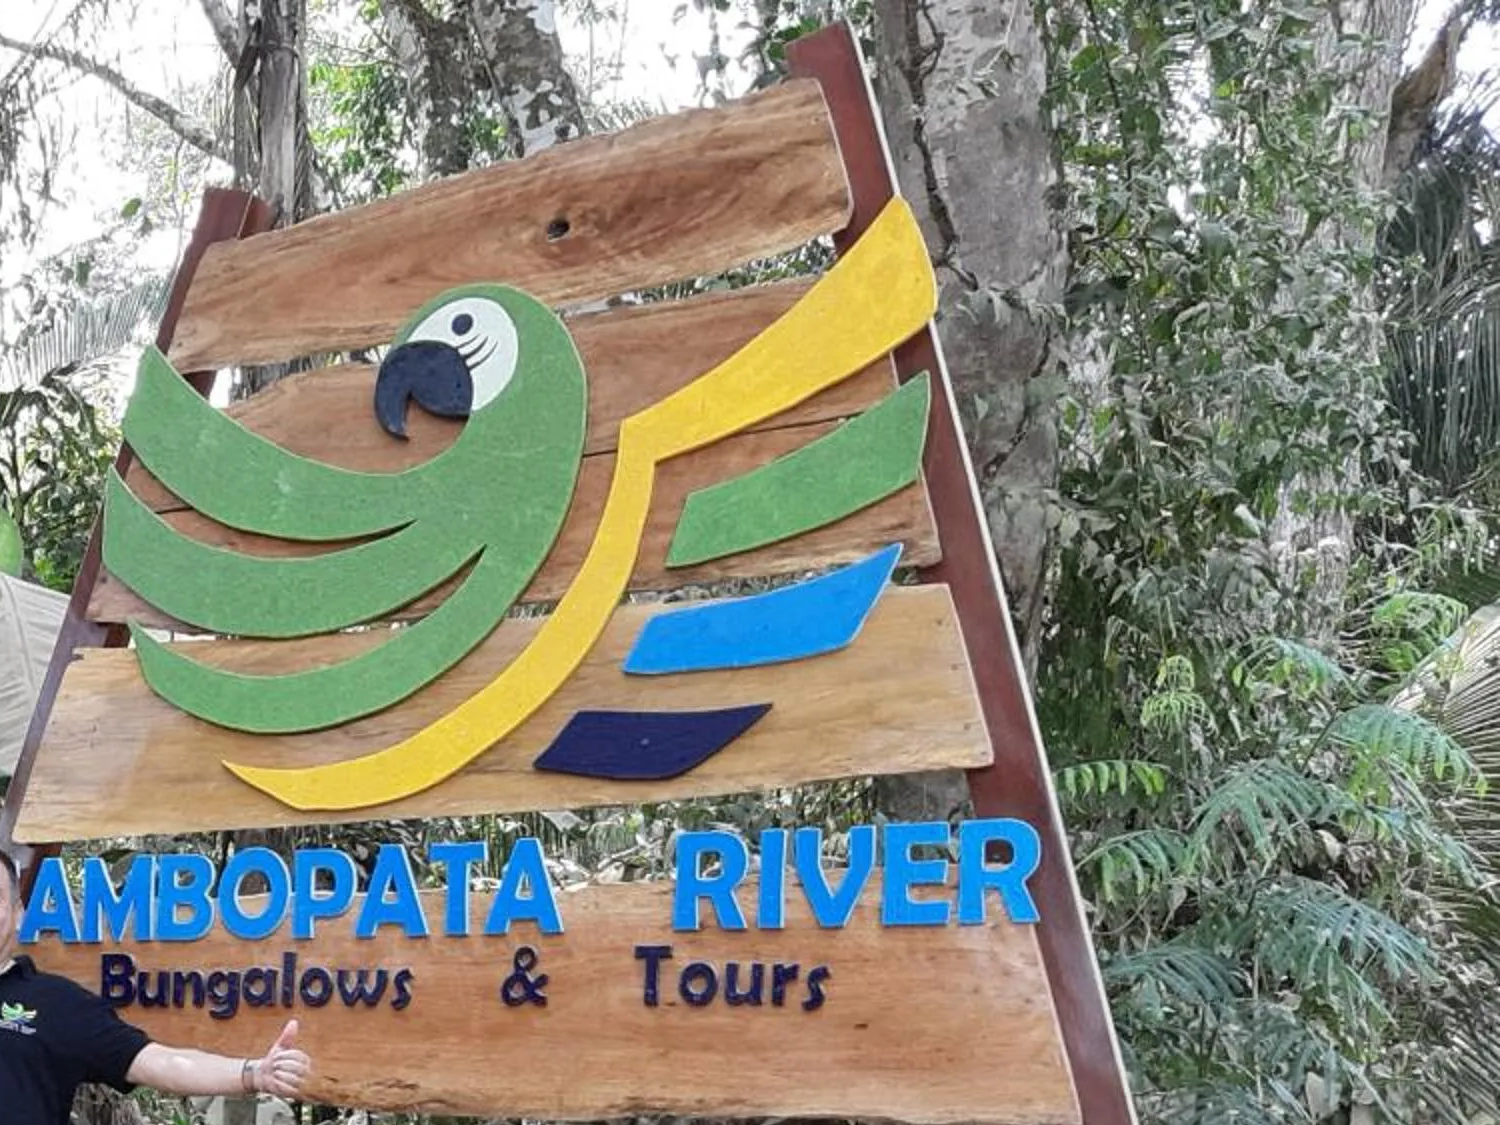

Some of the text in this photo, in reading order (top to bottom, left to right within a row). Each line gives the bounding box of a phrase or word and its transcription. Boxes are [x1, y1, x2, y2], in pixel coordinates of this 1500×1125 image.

[15, 817, 1042, 943] AMBOPATA RIVER
[100, 944, 833, 1020] Bungalows & Tours
